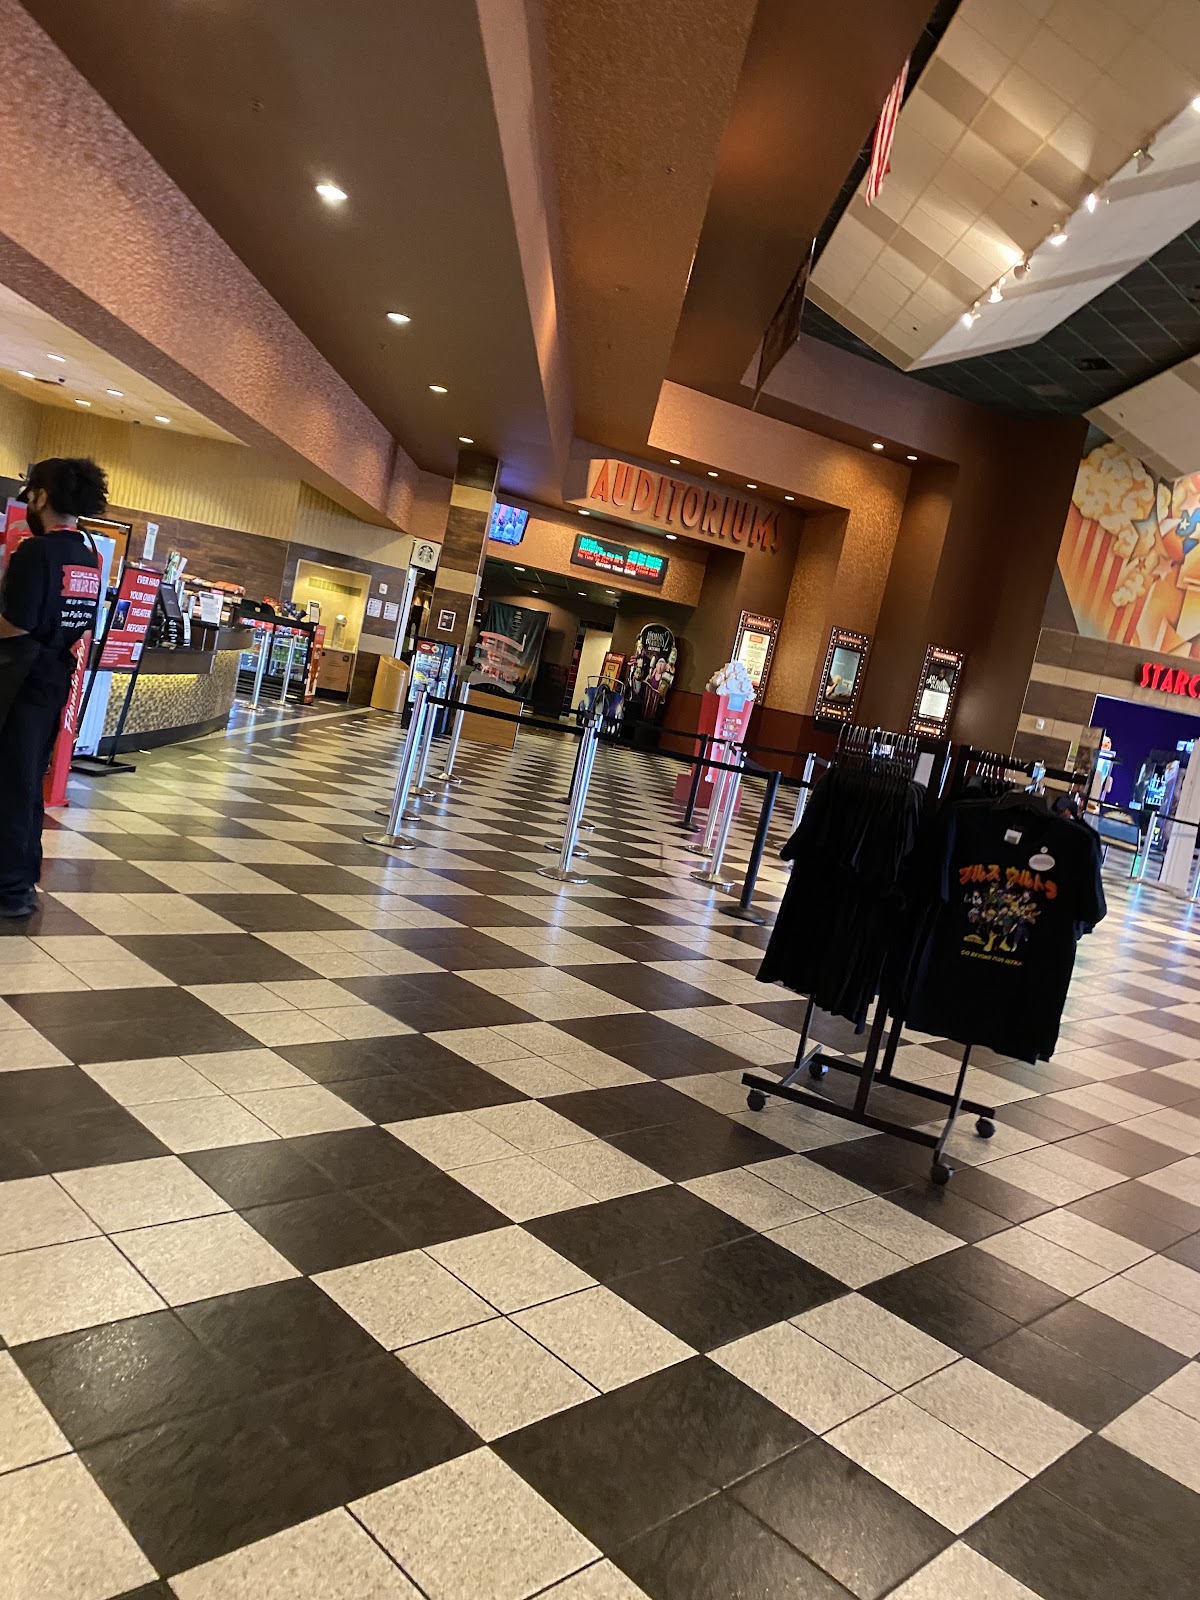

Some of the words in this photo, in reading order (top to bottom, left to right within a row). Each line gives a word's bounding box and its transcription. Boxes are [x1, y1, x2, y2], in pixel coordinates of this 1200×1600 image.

[591, 460, 781, 552] AUDITORIUMS
[136, 574, 149, 585] EVER
[149, 577, 160, 587] HAD
[130, 590, 143, 600] YOUR
